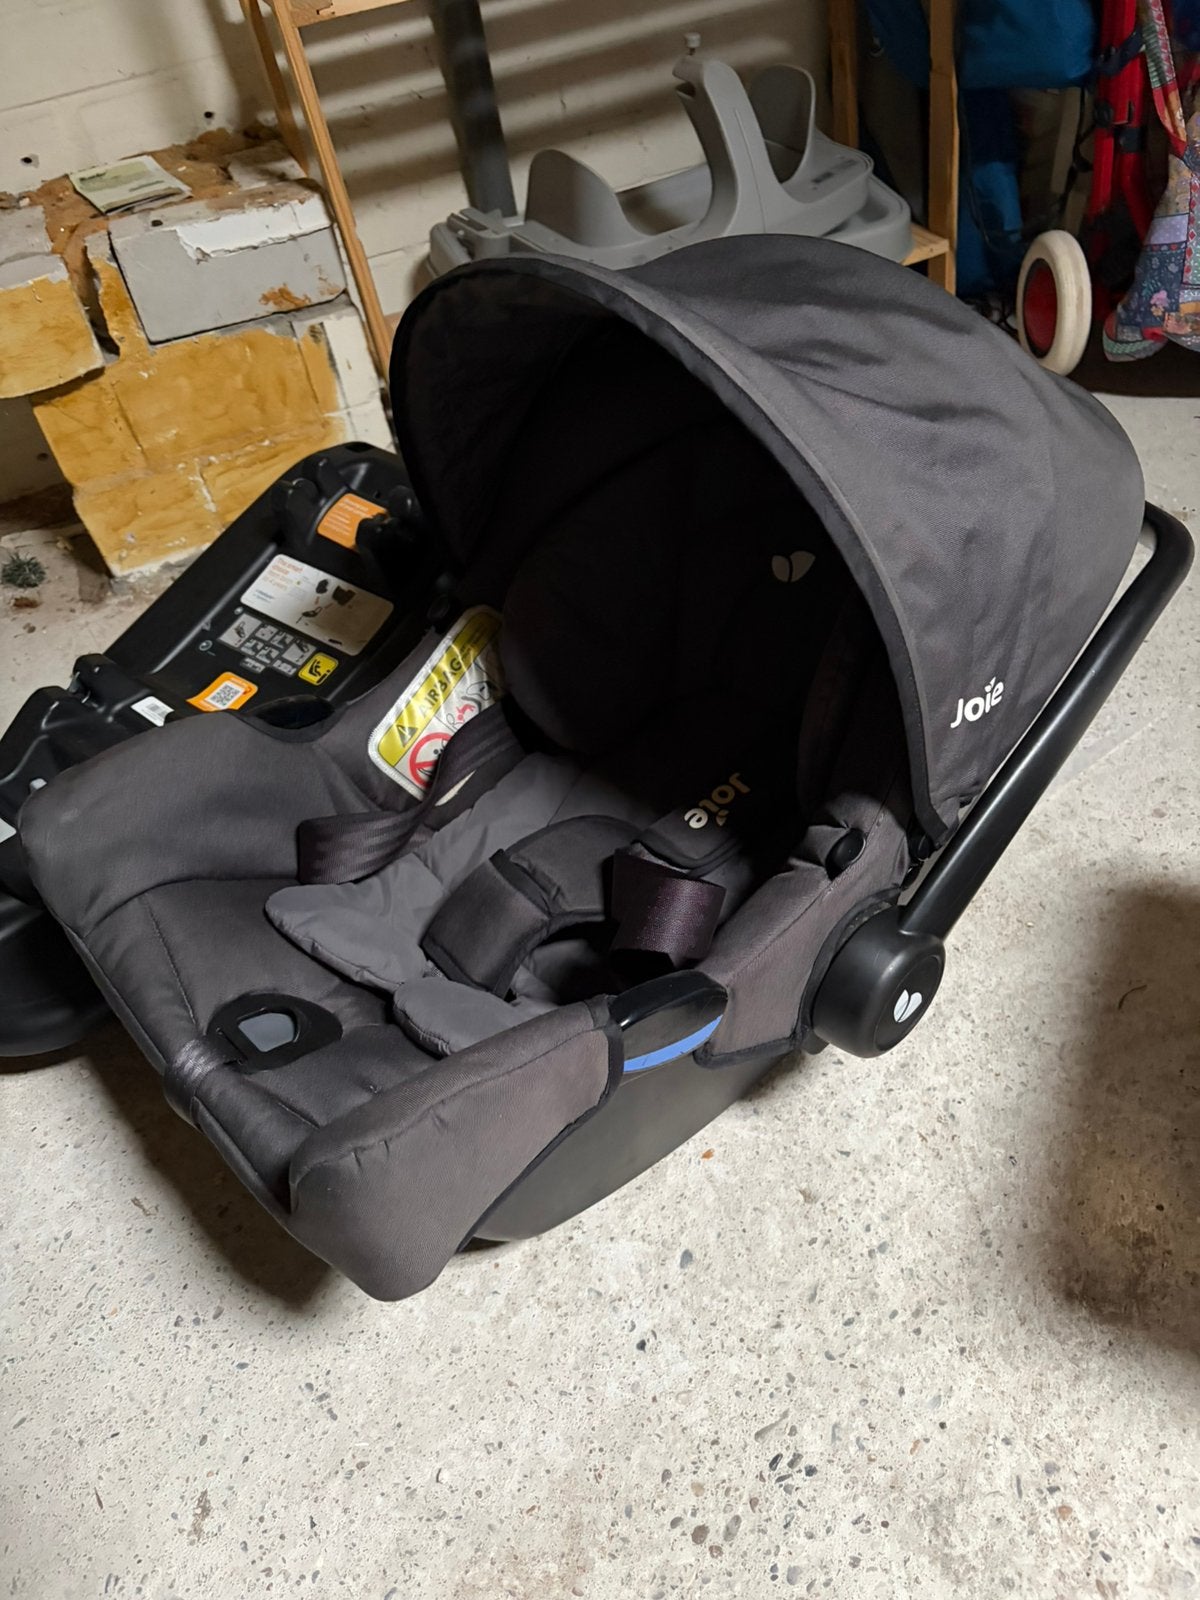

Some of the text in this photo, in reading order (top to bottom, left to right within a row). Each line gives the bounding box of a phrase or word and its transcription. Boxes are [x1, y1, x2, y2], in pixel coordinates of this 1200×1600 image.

[419, 657, 462, 718] AIRBAG
[950, 676, 1004, 729] Joie
[684, 772, 751, 829] Joie
